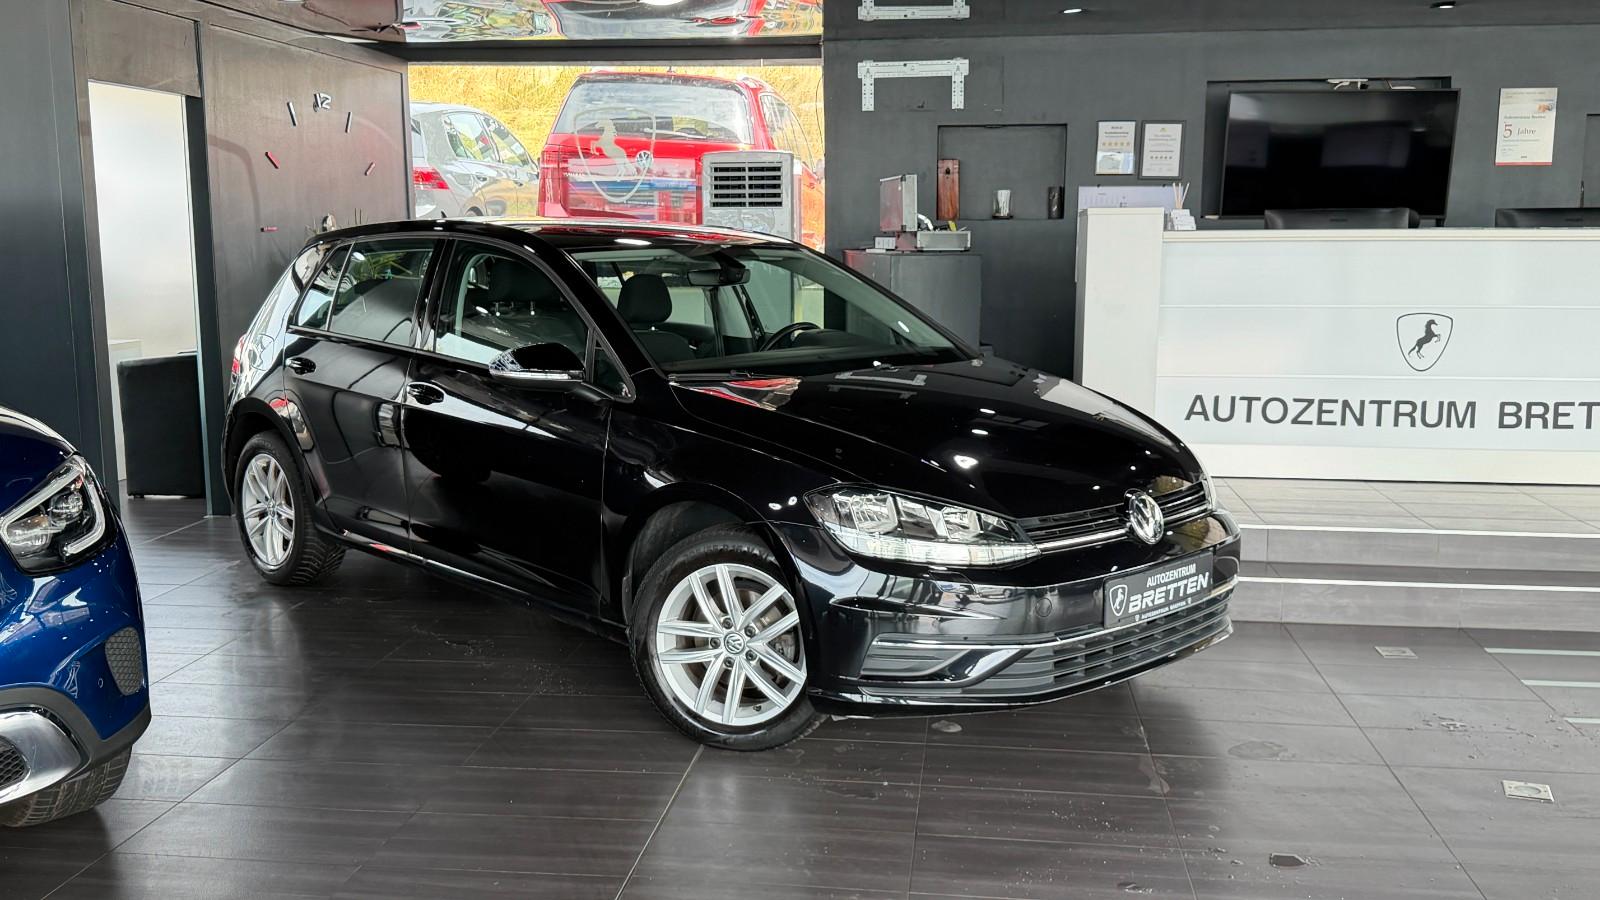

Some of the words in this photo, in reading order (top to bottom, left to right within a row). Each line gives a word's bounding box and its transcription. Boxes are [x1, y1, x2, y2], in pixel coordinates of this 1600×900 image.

[1503, 123, 1513, 139] 5
[1184, 394, 1477, 429] AUTOZENTRUM
[1498, 400, 1600, 430] BRET
[1146, 562, 1197, 588] AUTOZENTRUM
[1128, 571, 1210, 614] BRETTEN
